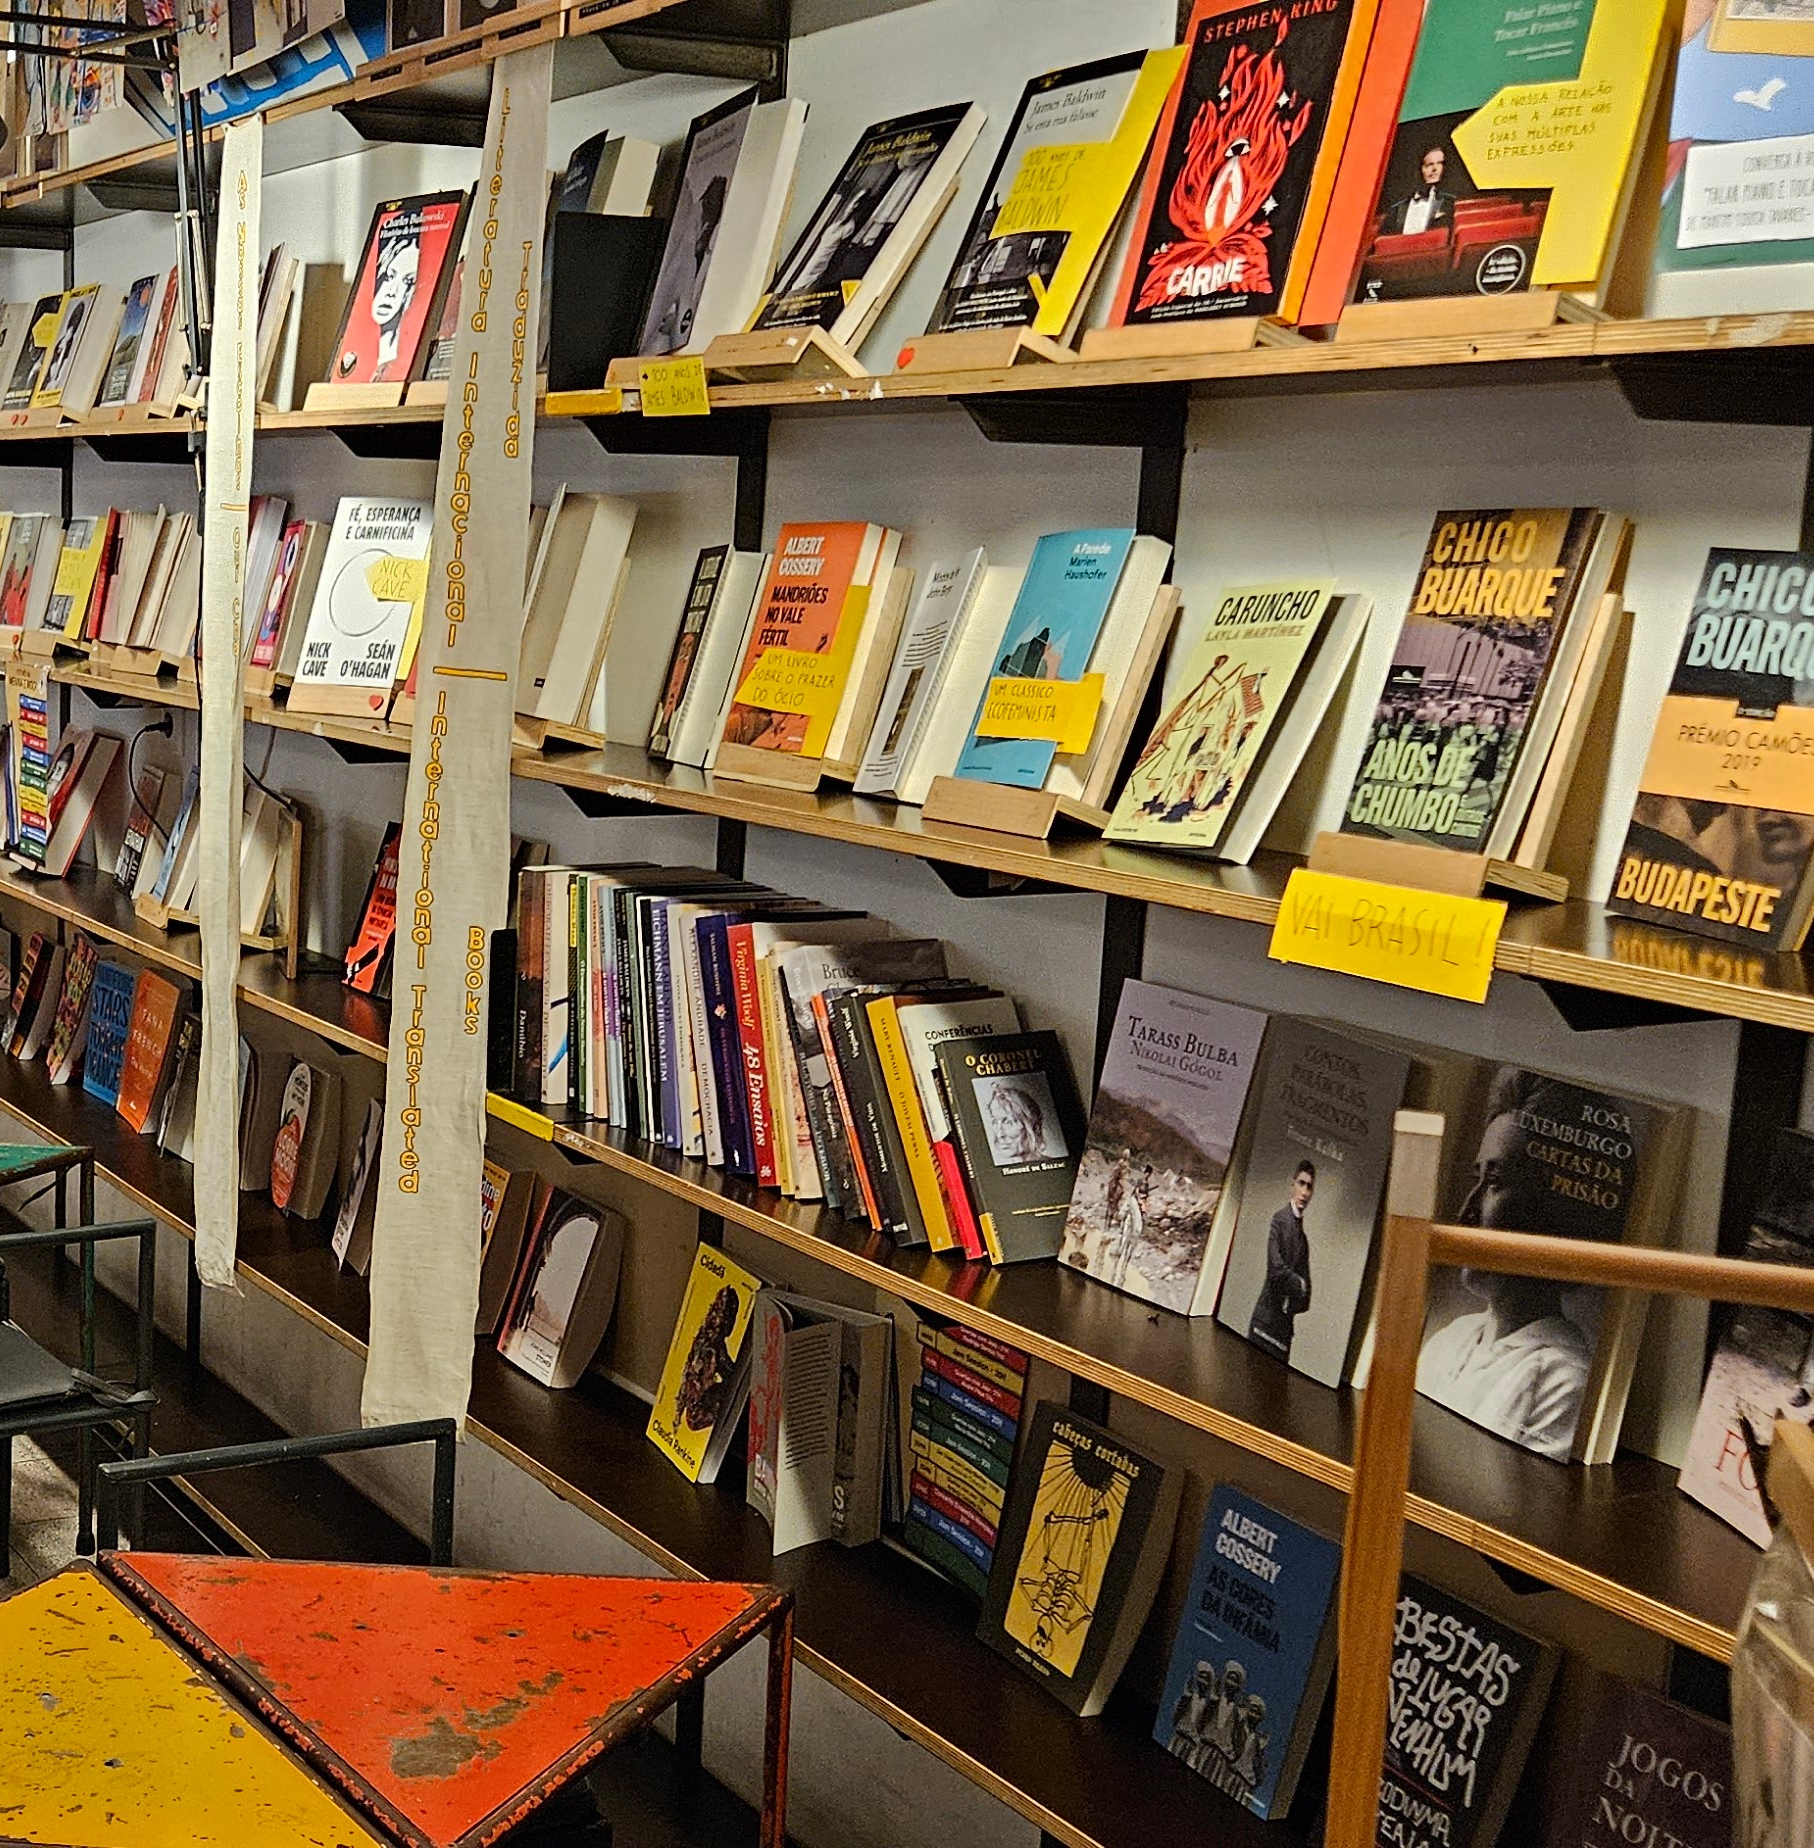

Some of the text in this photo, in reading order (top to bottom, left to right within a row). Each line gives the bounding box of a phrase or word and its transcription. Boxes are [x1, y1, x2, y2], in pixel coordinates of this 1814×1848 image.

[1202, 0, 1339, 44] STEPHEN KING
[1032, 87, 1107, 117] James Baldwin
[1012, 163, 1077, 195] JAMES
[382, 213, 410, 230] Charles
[1165, 256, 1248, 297] CARRIE
[502, 241, 533, 459] Traduzida
[444, 87, 512, 648] Literatura Internacional
[348, 503, 422, 524] FÉ, ESPERANÇA
[345, 525, 416, 542] E CARNIFICINA
[784, 536, 826, 557] ALBERT
[1433, 520, 1536, 564] CHICO
[380, 560, 414, 581] NICK
[778, 557, 825, 577] COSSERY
[1064, 568, 1109, 582] Haushofer
[1068, 555, 1098, 568] Marien
[371, 579, 410, 599] CAVE
[771, 582, 829, 605] MANDRIÕES
[1414, 566, 1566, 619] BUARQUE
[764, 606, 805, 625] NO VALE
[1213, 587, 1322, 628] CARUNCHO
[758, 625, 789, 647] FÉRTIL
[1205, 620, 1305, 643] LAYLA MARTÍNEZ
[306, 641, 332, 659] NICK
[366, 639, 396, 662] SEÁN
[767, 653, 819, 670] UM LIVRO
[302, 660, 329, 678] CAVE
[340, 659, 392, 680] O'HAGAN
[752, 667, 837, 689] SOBRE O PRAZER
[752, 686, 806, 707] DO ÓCIO
[993, 682, 1055, 700] UM CLÁSSICO
[987, 702, 1057, 724] ECOFEMINISTA
[1679, 724, 1740, 749] PRÉMIO
[1362, 736, 1478, 789] ANOS DE
[1721, 753, 1761, 772] 2019
[1349, 782, 1464, 836] CHUMBO
[1615, 857, 1782, 933] BUDAPESTE
[398, 690, 448, 1193] International Translated
[1292, 892, 1460, 967] VAI BRASIL
[652, 908, 662, 982] EICHMANN
[464, 925, 486, 1036] Books
[735, 940, 755, 1031] Virginia Woolf
[822, 963, 862, 980] Bruce
[655, 985, 664, 1007] EM
[925, 1022, 994, 1041] CONFERÊNCIAS
[1128, 1014, 1238, 1068] TARASS BULBA
[964, 1048, 1042, 1068] O CORONEL
[975, 1060, 1036, 1077] CHABERT
[1129, 1040, 1178, 1069] NIKOLAI
[1178, 1055, 1225, 1083] GÓGOL
[701, 1063, 715, 1136] DEMOCRACIA
[742, 1041, 769, 1148] 48 Ensaios
[879, 1017, 890, 1042] MARY
[885, 1044, 901, 1082] RENAULT
[900, 1099, 913, 1129] JOVEM
[907, 1130, 921, 1160] PERSA
[1580, 1105, 1632, 1135] ROSA
[1526, 1140, 1624, 1186] CARTAS DA
[1550, 1173, 1619, 1211] PRISÃO
[699, 1253, 726, 1280] Cidadã
[651, 1419, 697, 1470] Claudia Rankine
[1052, 1420, 1140, 1478] cabeças cortadas
[1220, 1507, 1278, 1554] ALBERT
[1215, 1531, 1282, 1585] COSSERY
[1393, 1596, 1522, 1707] BESTAS
[1391, 1649, 1493, 1760] de LUGAR
[1602, 1767, 1635, 1799] DA
[1607, 1732, 1726, 1814] JOGOS
